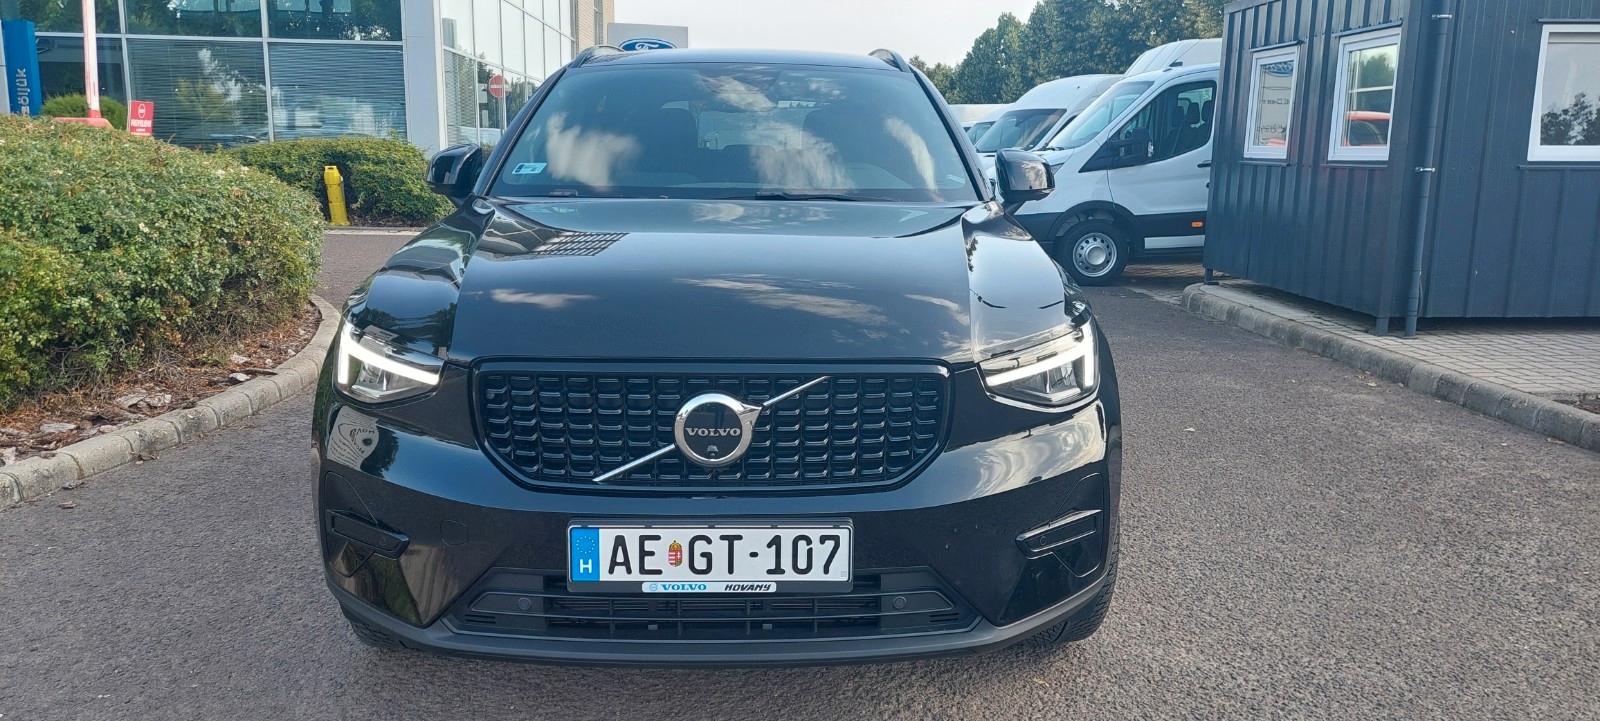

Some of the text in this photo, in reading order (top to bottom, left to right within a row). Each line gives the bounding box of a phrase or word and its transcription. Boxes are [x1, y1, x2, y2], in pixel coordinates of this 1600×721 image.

[684, 427, 741, 437] VOLVO
[608, 535, 841, 575] AE GT-107
[579, 559, 592, 574] H
[662, 583, 707, 592] VOLVO
